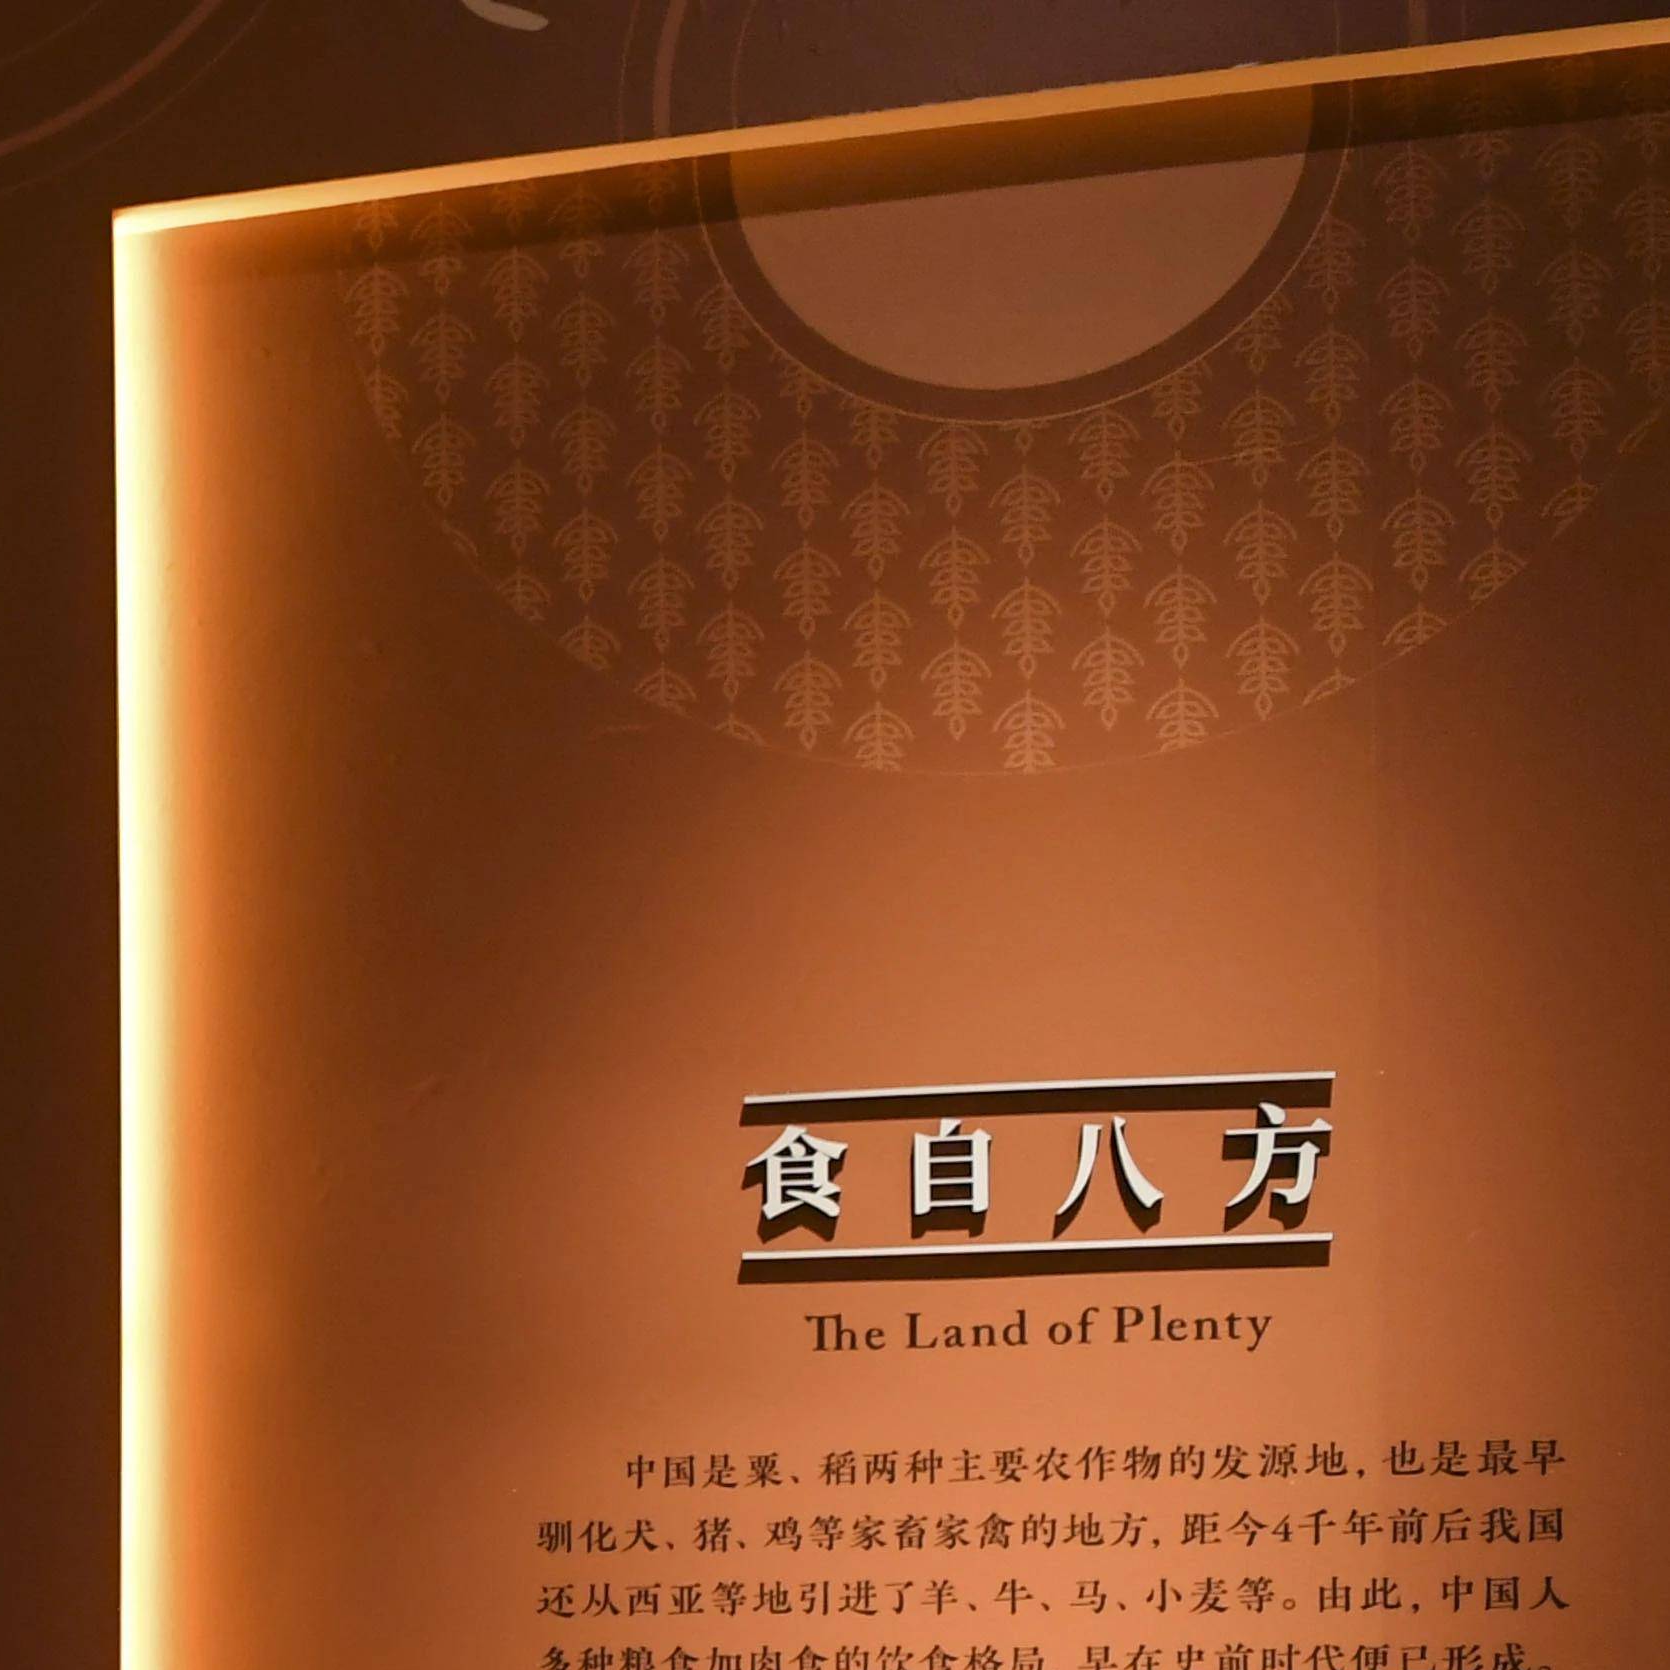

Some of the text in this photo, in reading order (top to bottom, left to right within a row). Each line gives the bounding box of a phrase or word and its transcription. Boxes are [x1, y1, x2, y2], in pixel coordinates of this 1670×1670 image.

[745, 1102, 1333, 1220] 食自八方
[804, 1304, 1272, 1353] The Land of Plenty
[627, 1439, 1565, 1490] 中国是粟、稻两种主要农作物的发源地，也是最早
[537, 1506, 1562, 1554] 驯化犬、猪、鸡等家畜家禽的地方，距今4千年前后我国
[537, 1575, 1568, 1619] 还从西亚等地引进了羊、牛、马、小麦等。由此，中国人
